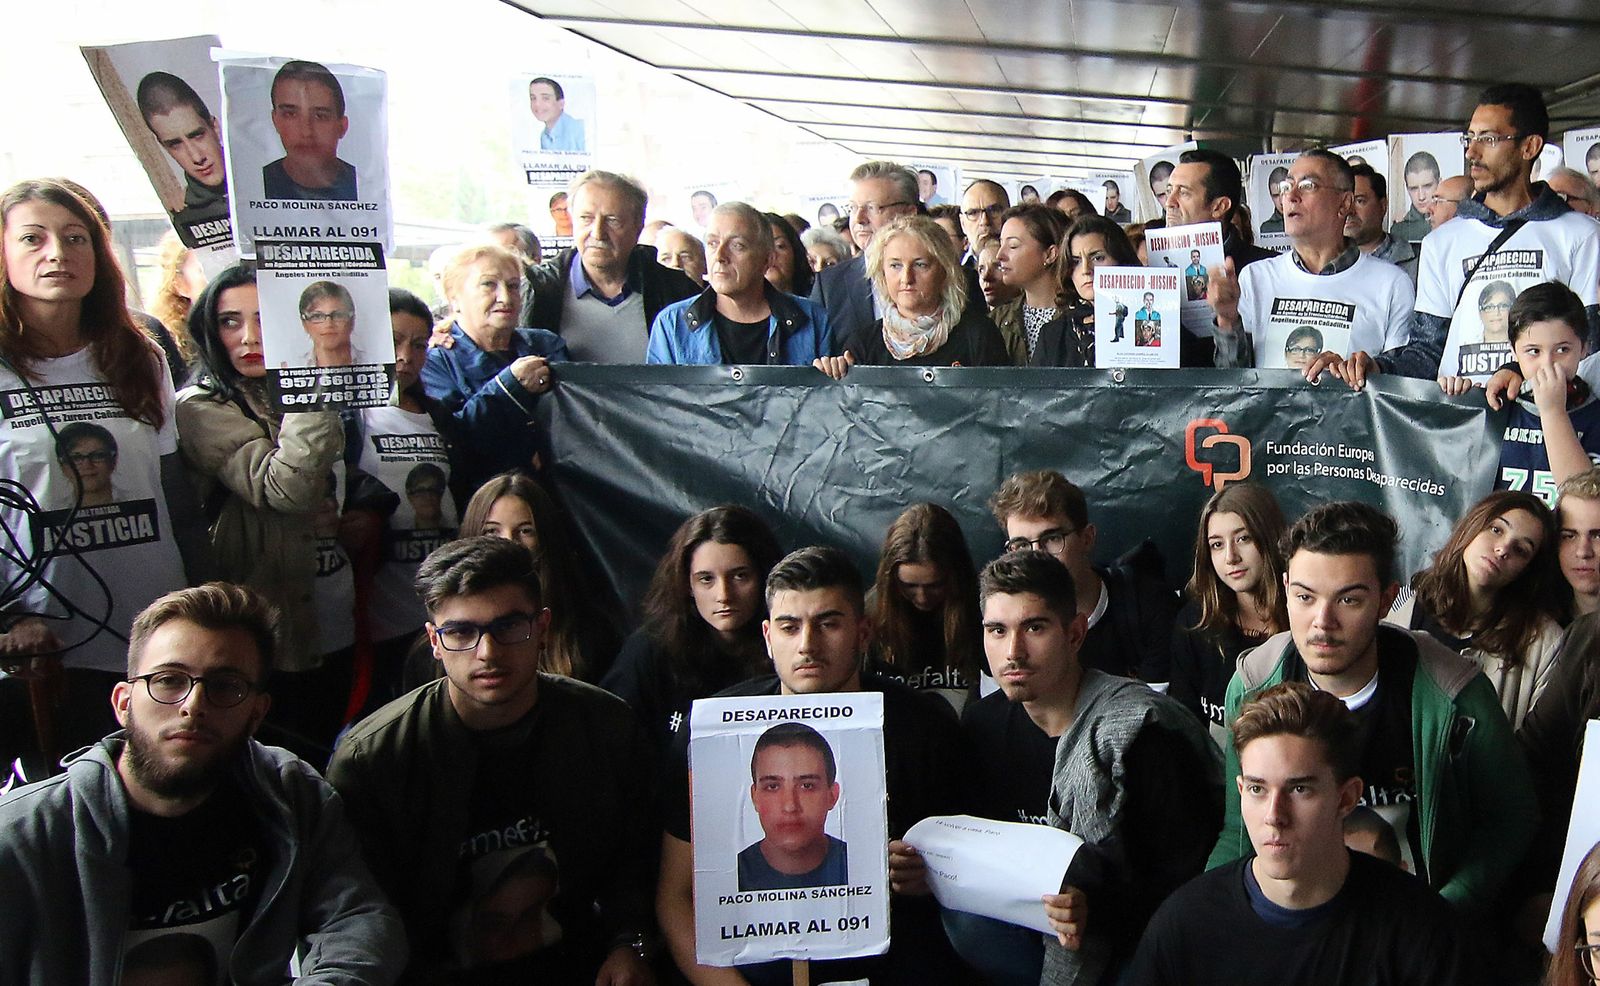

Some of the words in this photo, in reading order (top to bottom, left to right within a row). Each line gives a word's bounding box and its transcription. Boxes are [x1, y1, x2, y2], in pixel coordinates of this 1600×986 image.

[249, 201, 278, 209] PACO
[282, 201, 325, 210] MOLINA
[190, 219, 230, 239] DESAP
[253, 226, 321, 237] LLAMAR
[326, 226, 346, 237] AL
[351, 226, 378, 238] 091
[263, 245, 376, 260] DESAPARECIDA
[1467, 251, 1537, 271] DAPARECIDA
[1099, 274, 1145, 289] DESAPARECIDO
[1277, 300, 1349, 317] DESAPARECIDA
[280, 376, 316, 389] 957
[319, 374, 353, 386] 660
[356, 373, 388, 384] 013
[8, 386, 115, 409] DEAPARECI
[281, 393, 318, 405] 647
[321, 391, 354, 403] 768
[357, 388, 389, 400] 416
[11, 416, 61, 430] Angelies
[380, 436, 442, 449] DESAPAREC
[1266, 441, 1335, 456] Fundación
[1338, 444, 1375, 463] Europea
[1267, 463, 1290, 476] por
[1293, 461, 1311, 475] las
[1314, 462, 1365, 480] Personas
[1366, 467, 1446, 496] Desaparecidas
[1502, 467, 1559, 511] 75
[722, 706, 854, 723] DESAPARECIDO
[719, 893, 754, 905] PACO
[757, 892, 808, 903] MOLINA
[811, 886, 873, 899] SÁNCHEZ
[721, 920, 801, 940] LLAMAR
[807, 919, 832, 933] AL
[837, 916, 871, 931] 091
